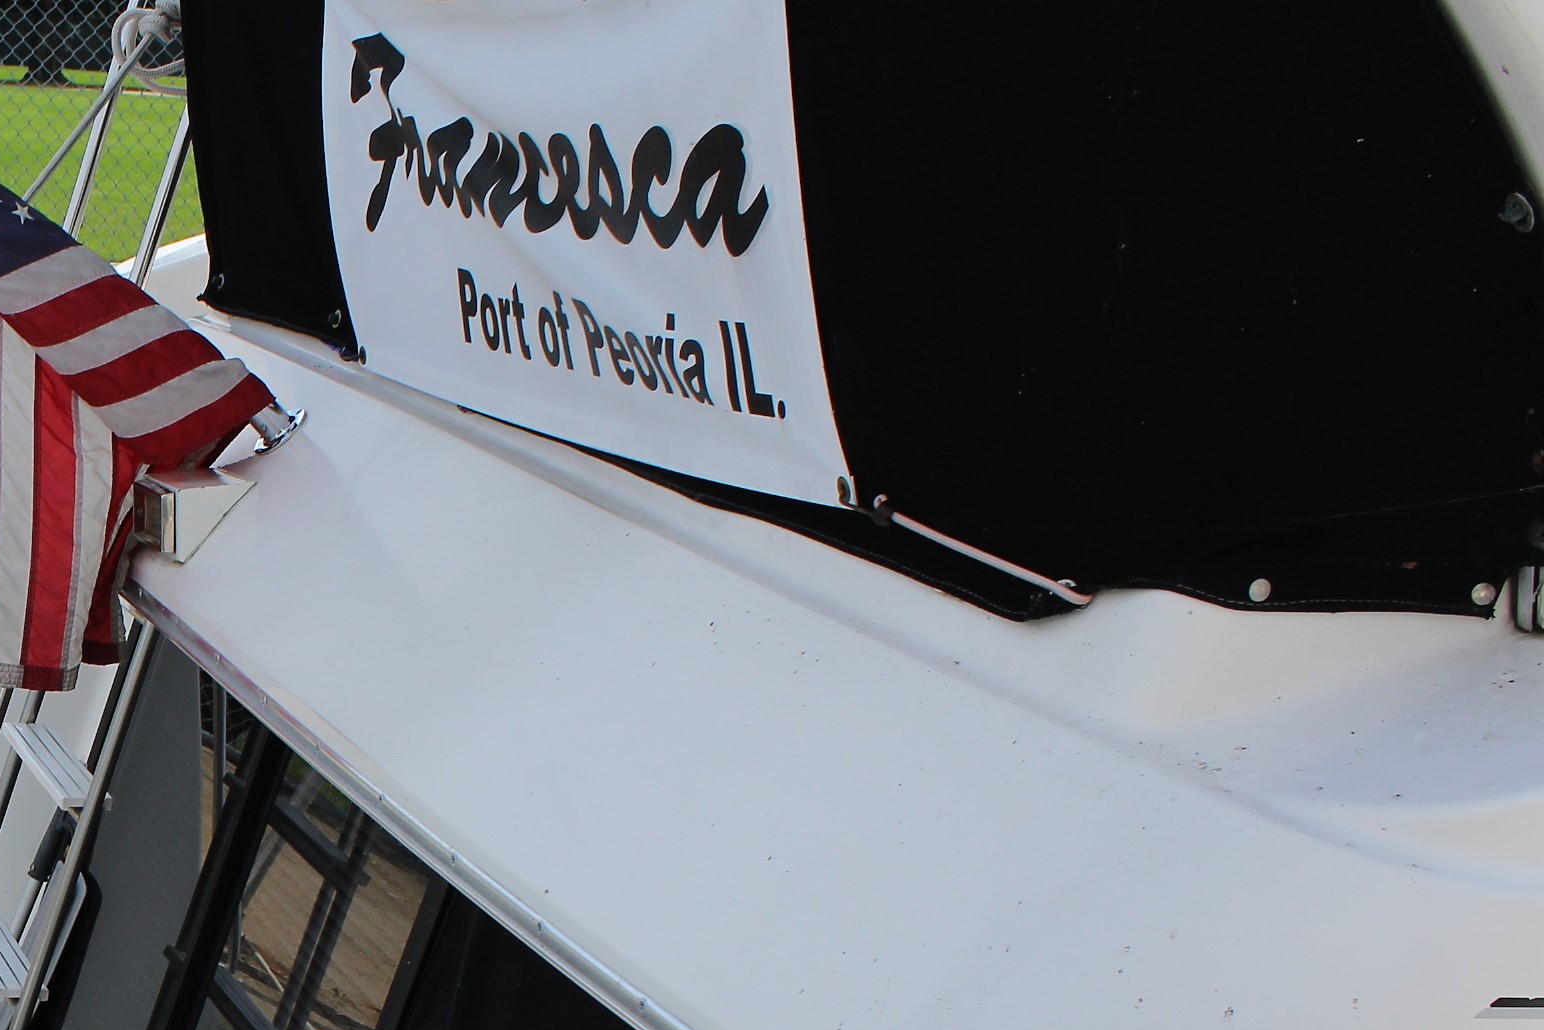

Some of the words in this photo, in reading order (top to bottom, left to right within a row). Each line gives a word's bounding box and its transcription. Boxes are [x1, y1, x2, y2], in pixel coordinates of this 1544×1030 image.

[351, 33, 769, 257] Francesca
[457, 268, 531, 361] Port
[538, 291, 573, 370] of
[571, 298, 714, 406] Peoria
[718, 320, 786, 419] IL.
